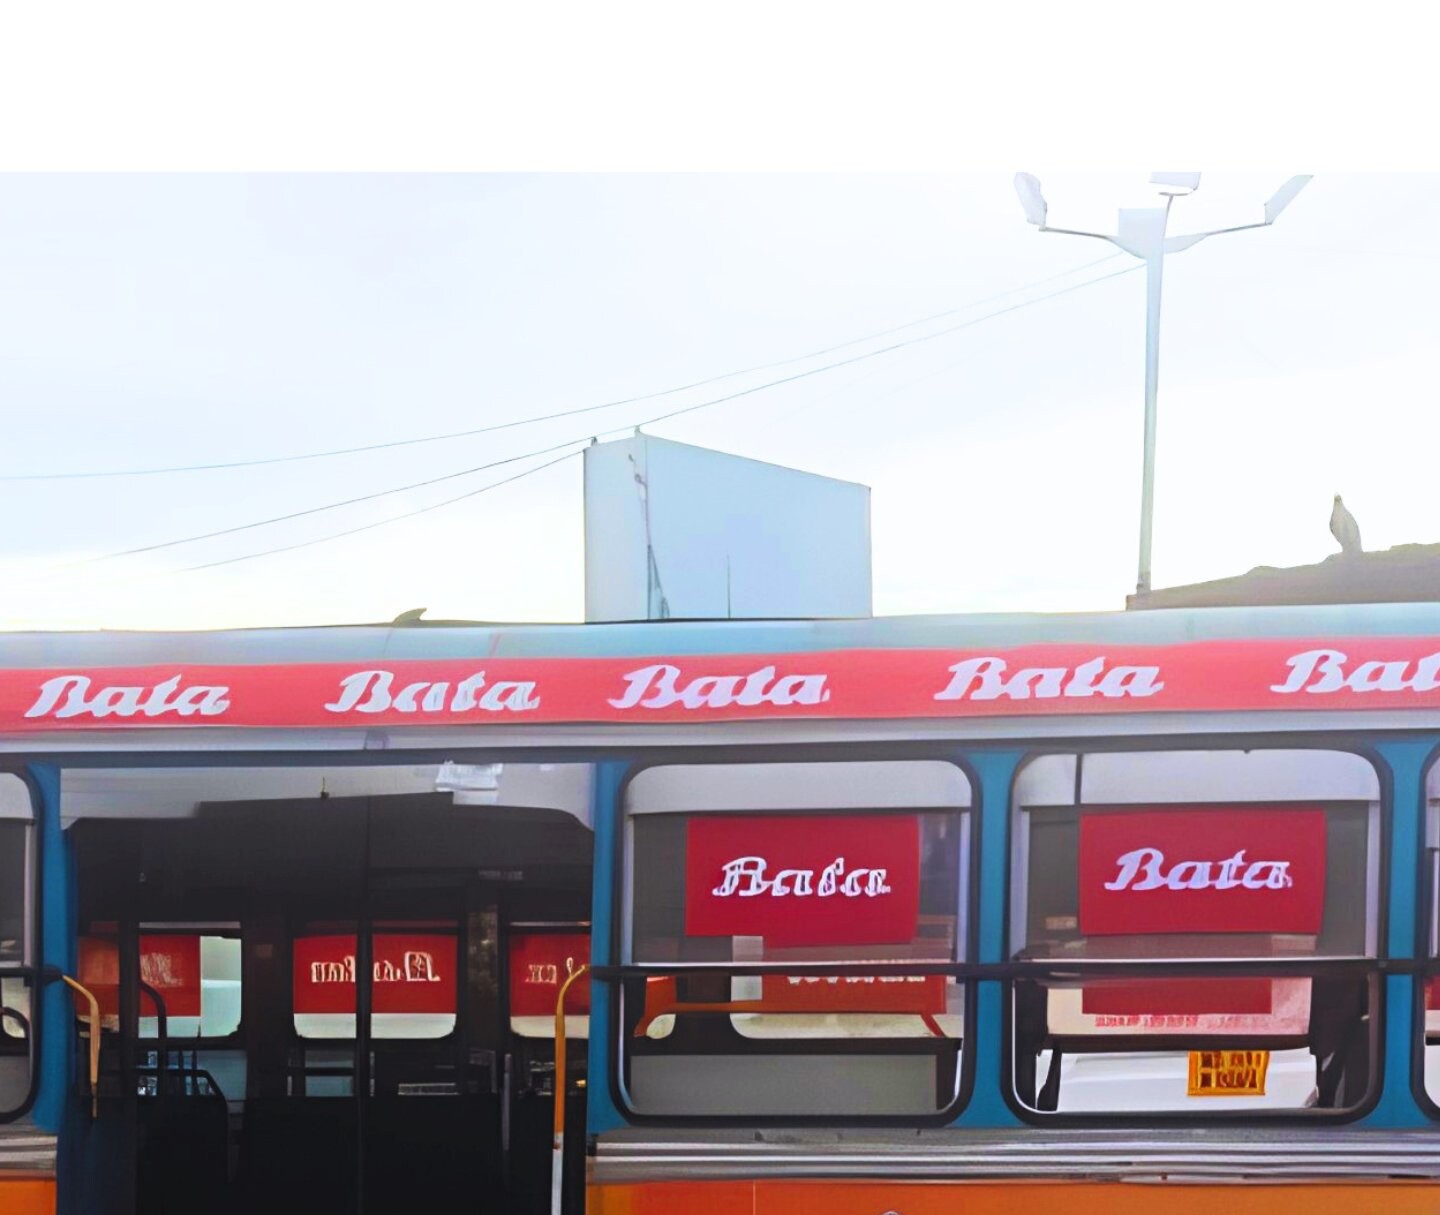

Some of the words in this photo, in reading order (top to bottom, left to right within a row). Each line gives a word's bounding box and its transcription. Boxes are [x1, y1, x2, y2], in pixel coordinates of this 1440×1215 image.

[25, 674, 230, 717] Bata
[325, 670, 540, 712] Bata
[608, 665, 830, 708] Bata
[935, 656, 1164, 699] Bata
[712, 857, 891, 897] Bata
[1105, 848, 1292, 890] Bata
